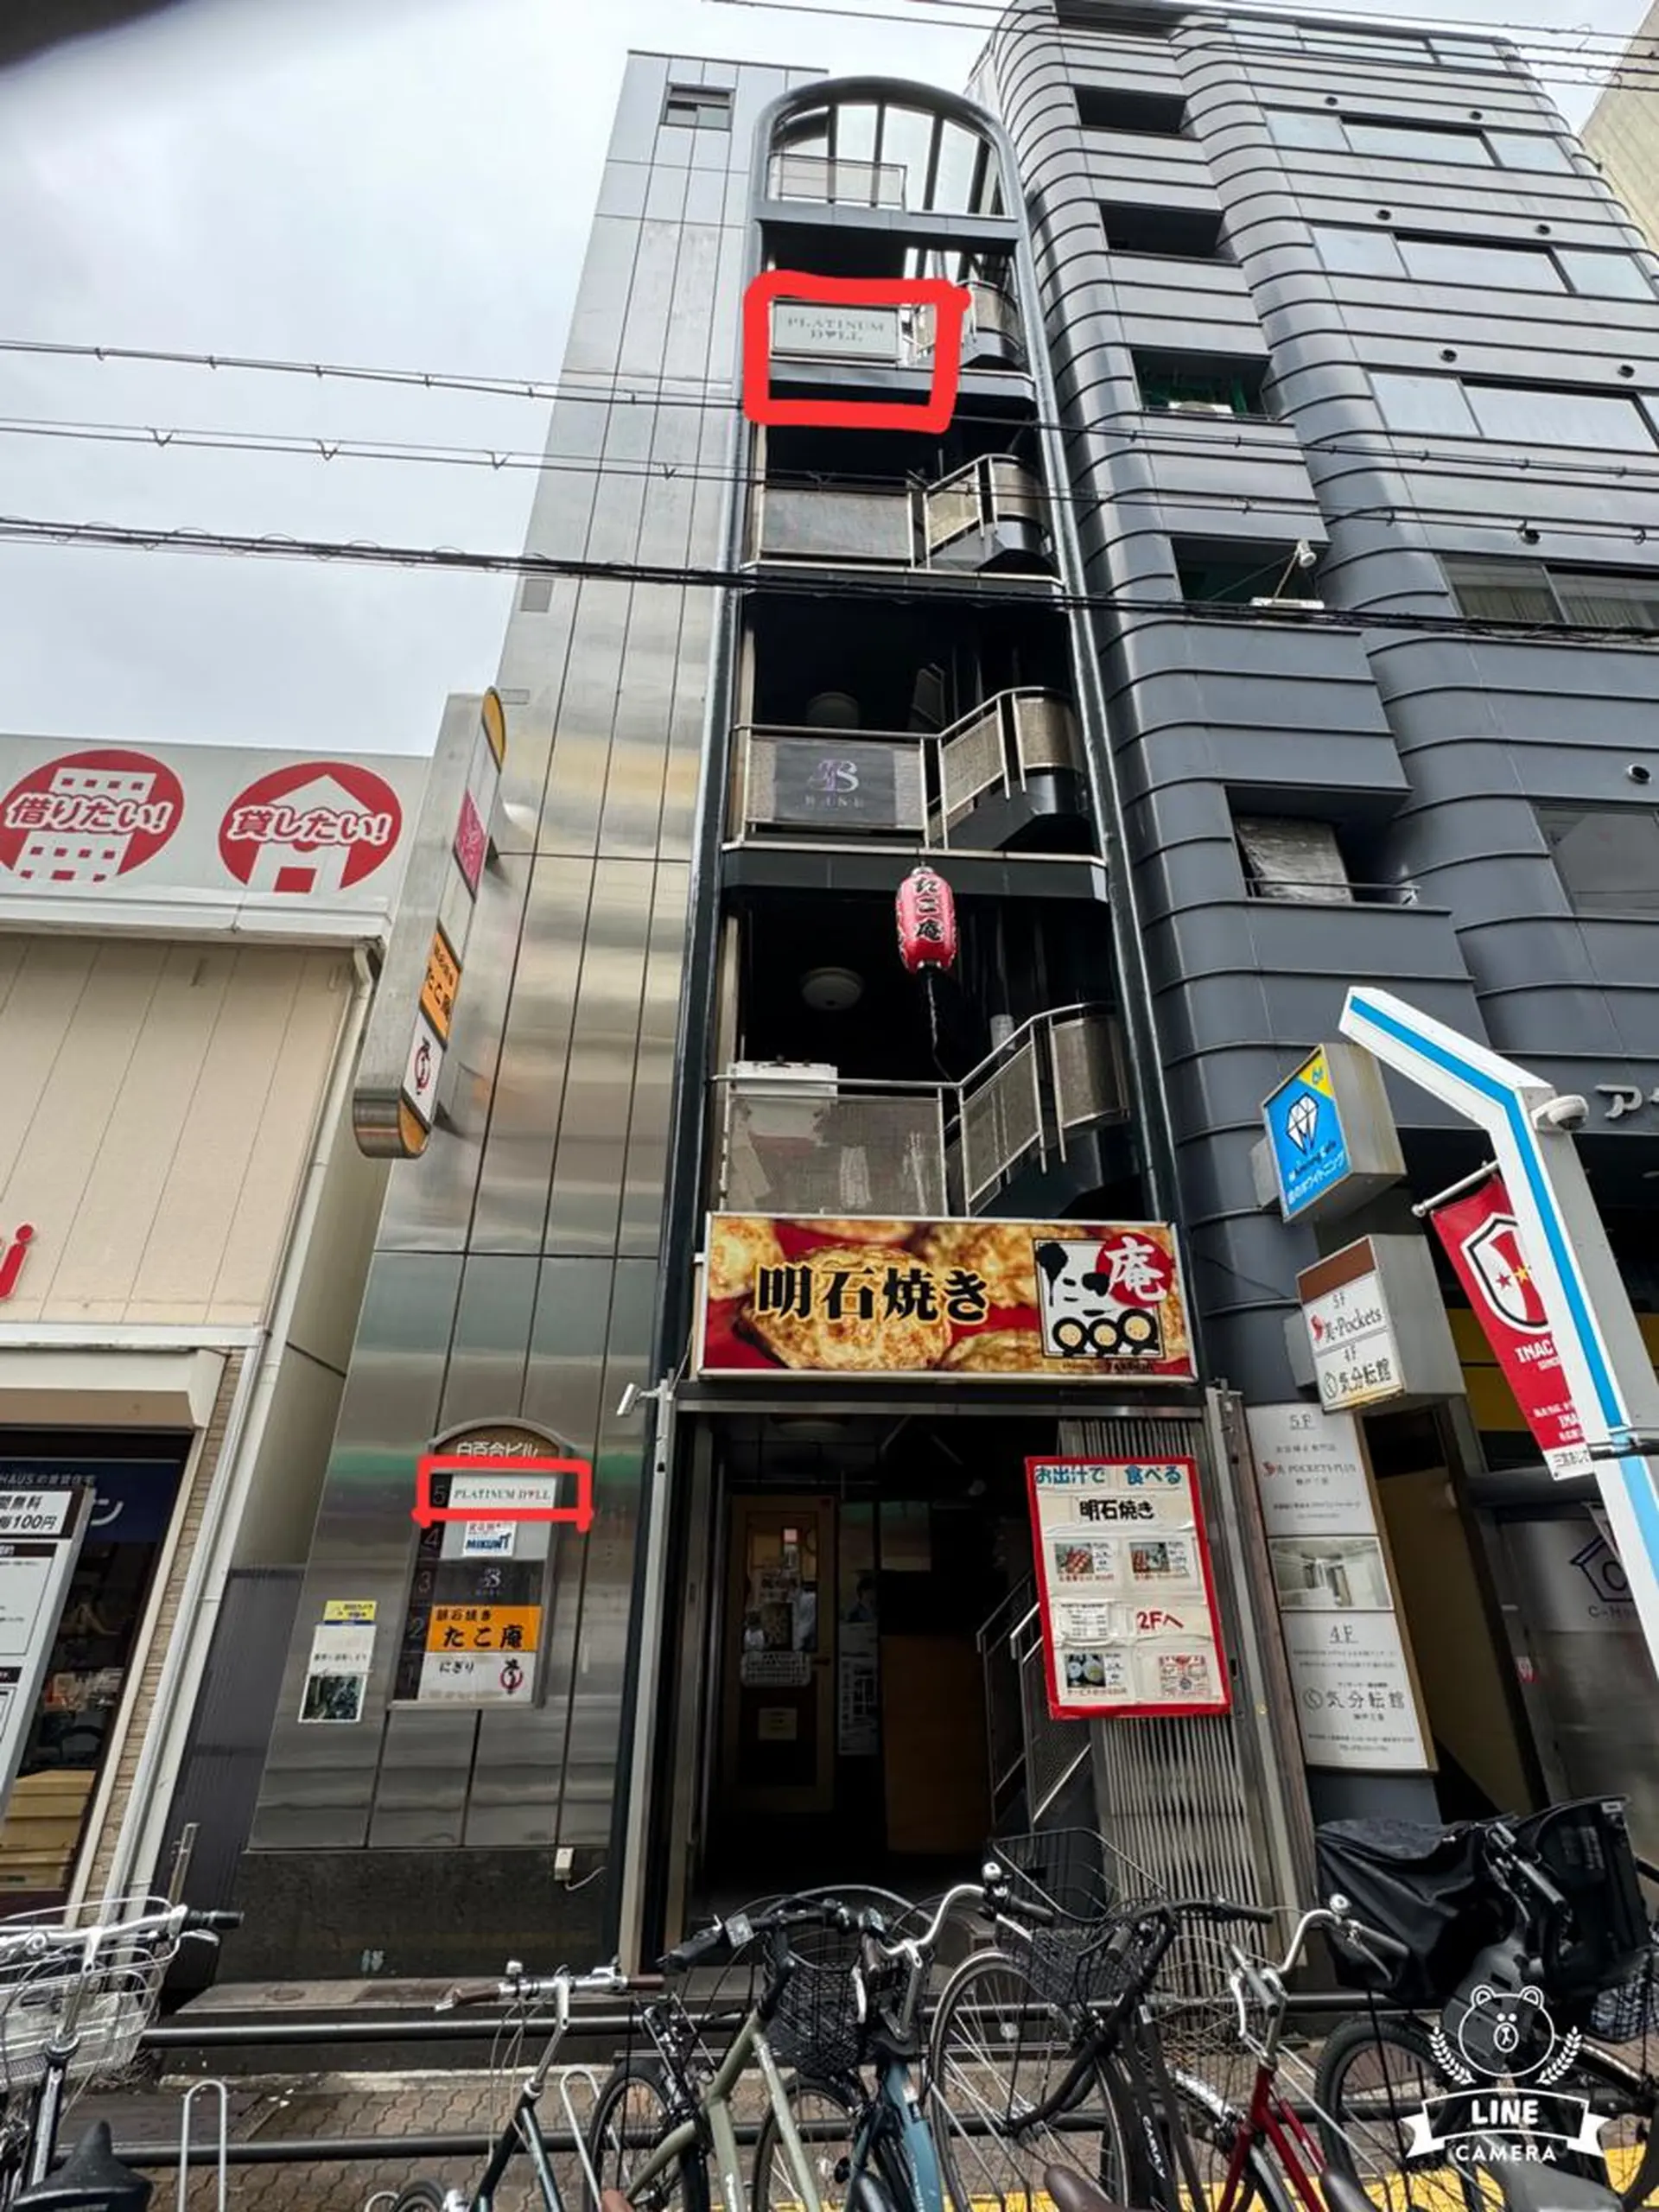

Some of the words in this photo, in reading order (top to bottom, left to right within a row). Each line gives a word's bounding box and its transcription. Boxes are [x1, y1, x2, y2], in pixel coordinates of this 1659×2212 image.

[787, 316, 885, 331] PLATINUM
[756, 1264, 987, 1324] 明石焼き
[1034, 1465, 1106, 1485] お出汁で
[1123, 1465, 1183, 1486] 食べる
[453, 1488, 516, 1501] PLATINUM
[1079, 1499, 1156, 1521] 明石焼き
